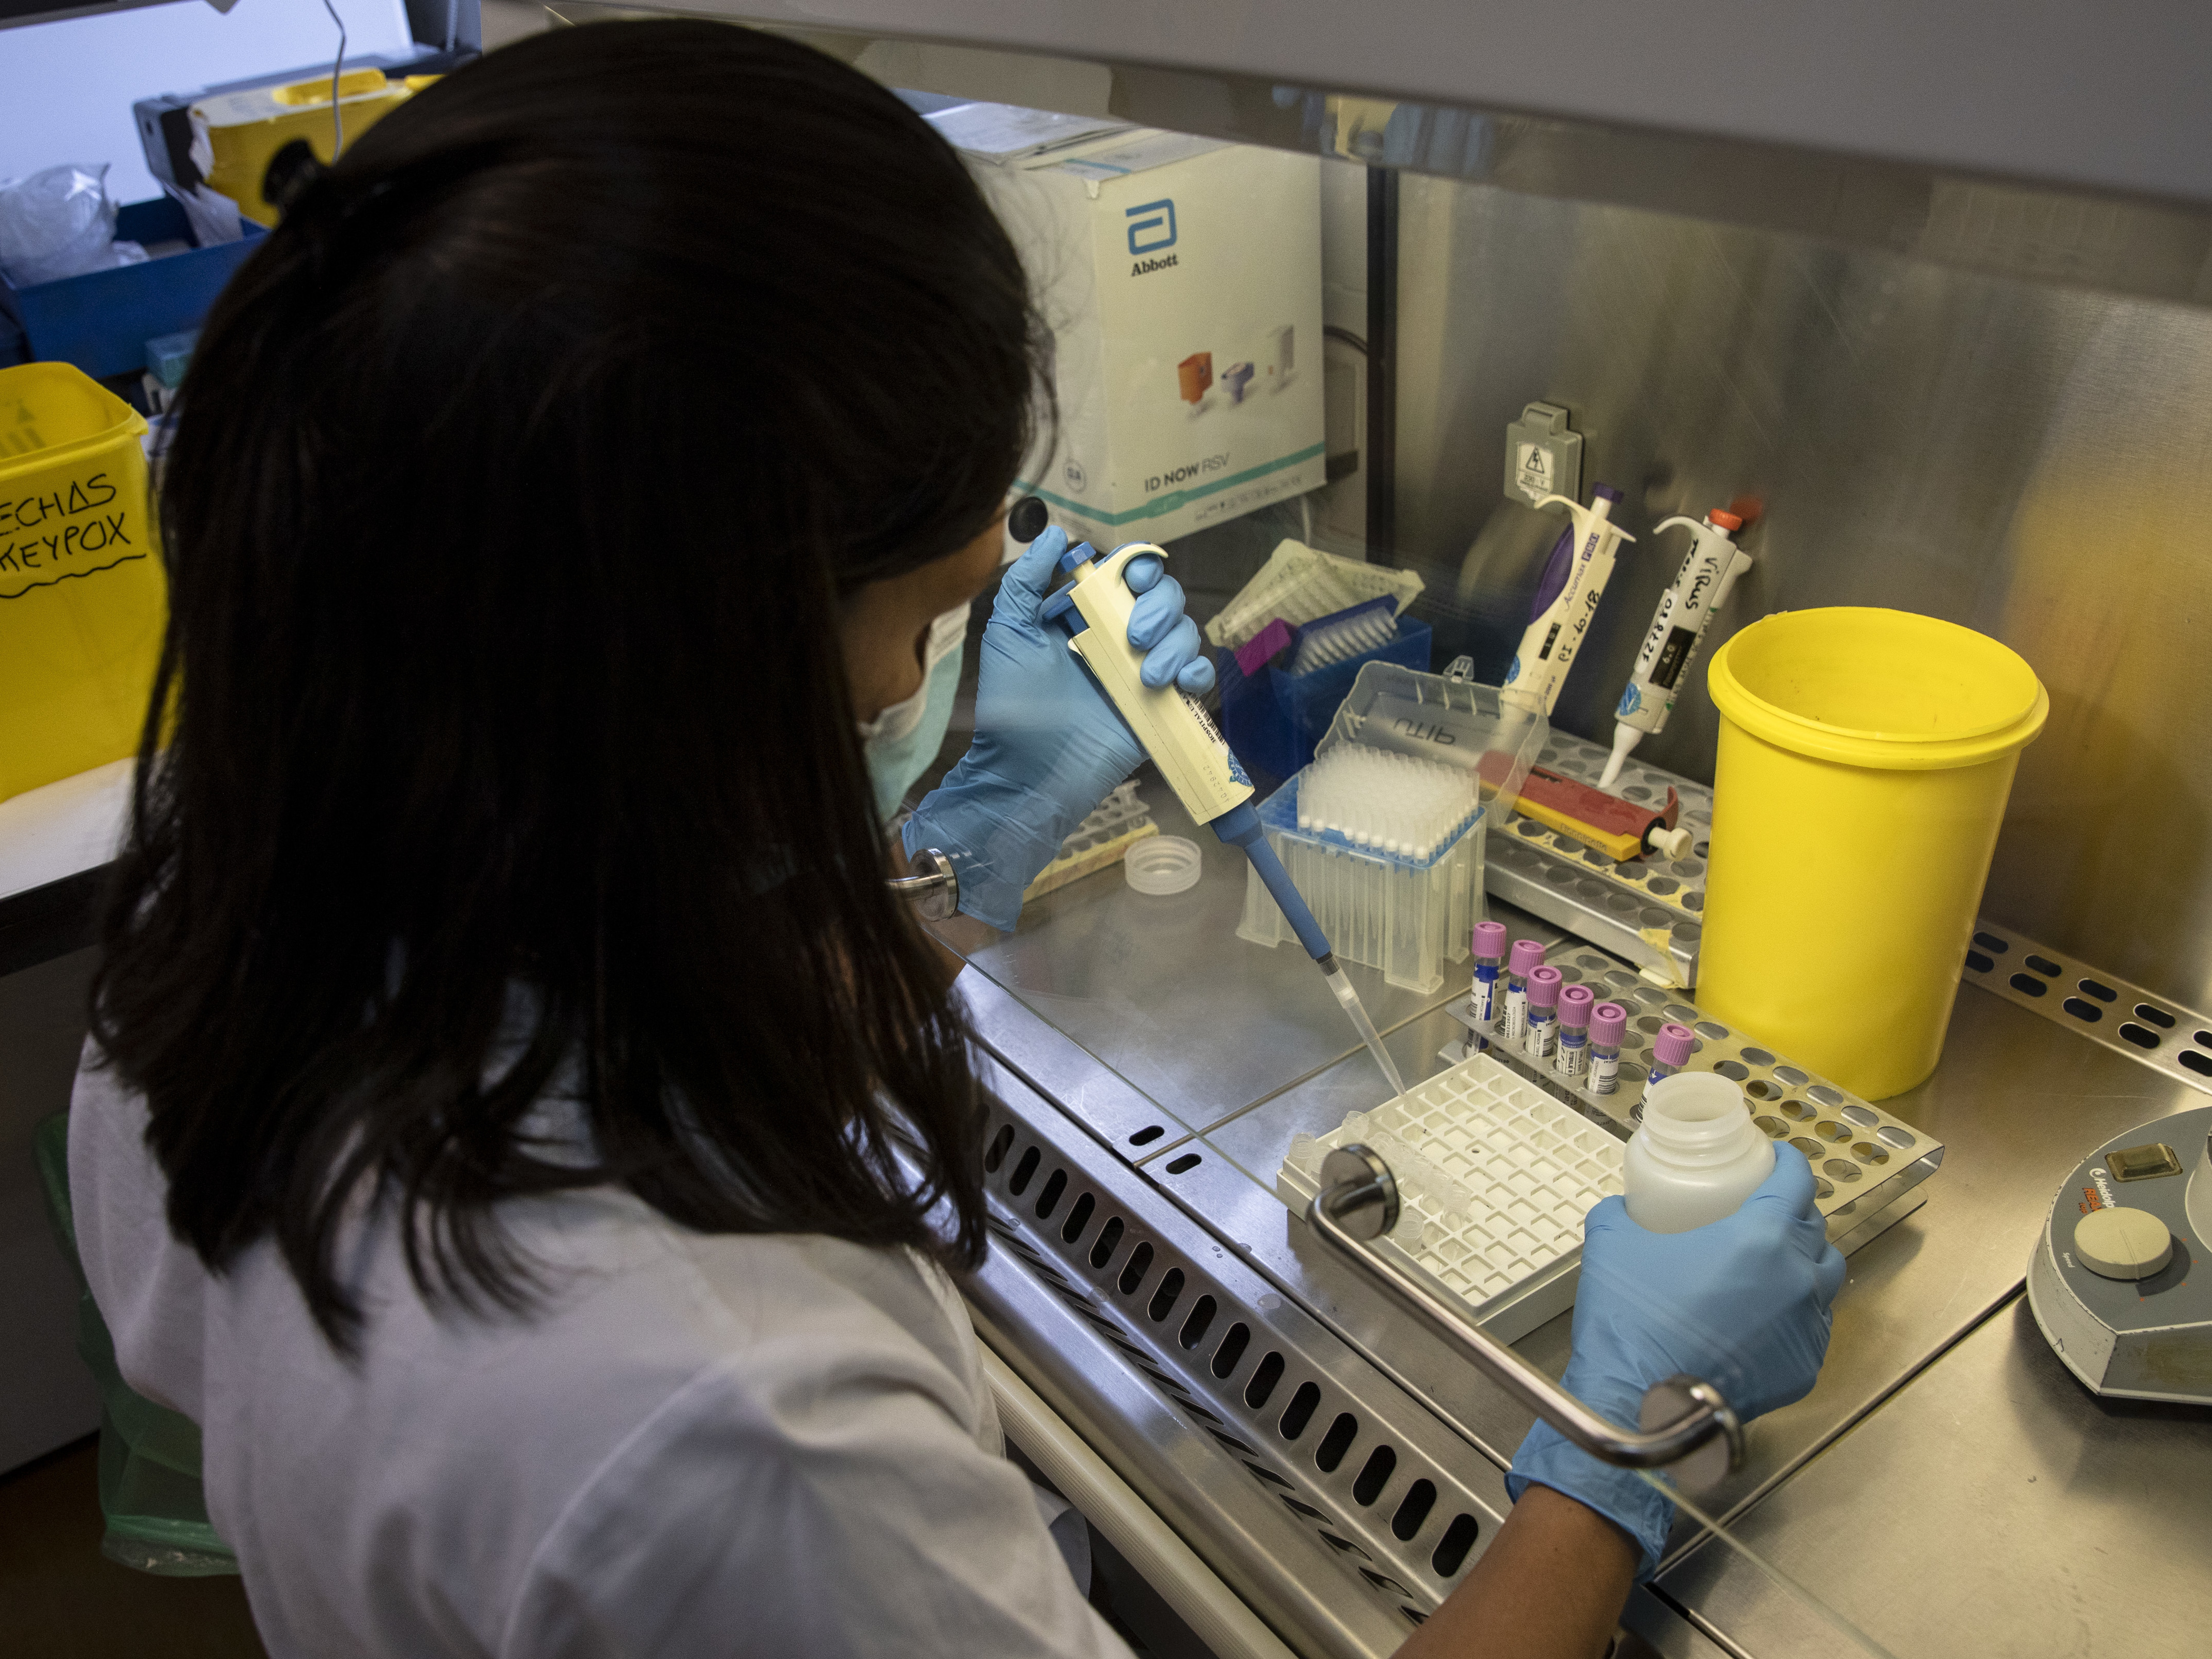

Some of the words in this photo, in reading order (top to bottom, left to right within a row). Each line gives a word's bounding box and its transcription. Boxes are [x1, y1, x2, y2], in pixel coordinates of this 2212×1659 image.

[1130, 254, 1179, 277] Abbott
[1144, 476, 1161, 493] ID
[1164, 463, 1200, 487] NOW
[1201, 451, 1231, 473] RSV
[1564, 563, 1585, 610] Accumax
[1581, 532, 1600, 562] PRO
[2078, 1202, 2088, 1214] top
[1193, 1228, 1216, 1260] HOSPITAL
[2062, 1251, 2075, 1269] Speed
